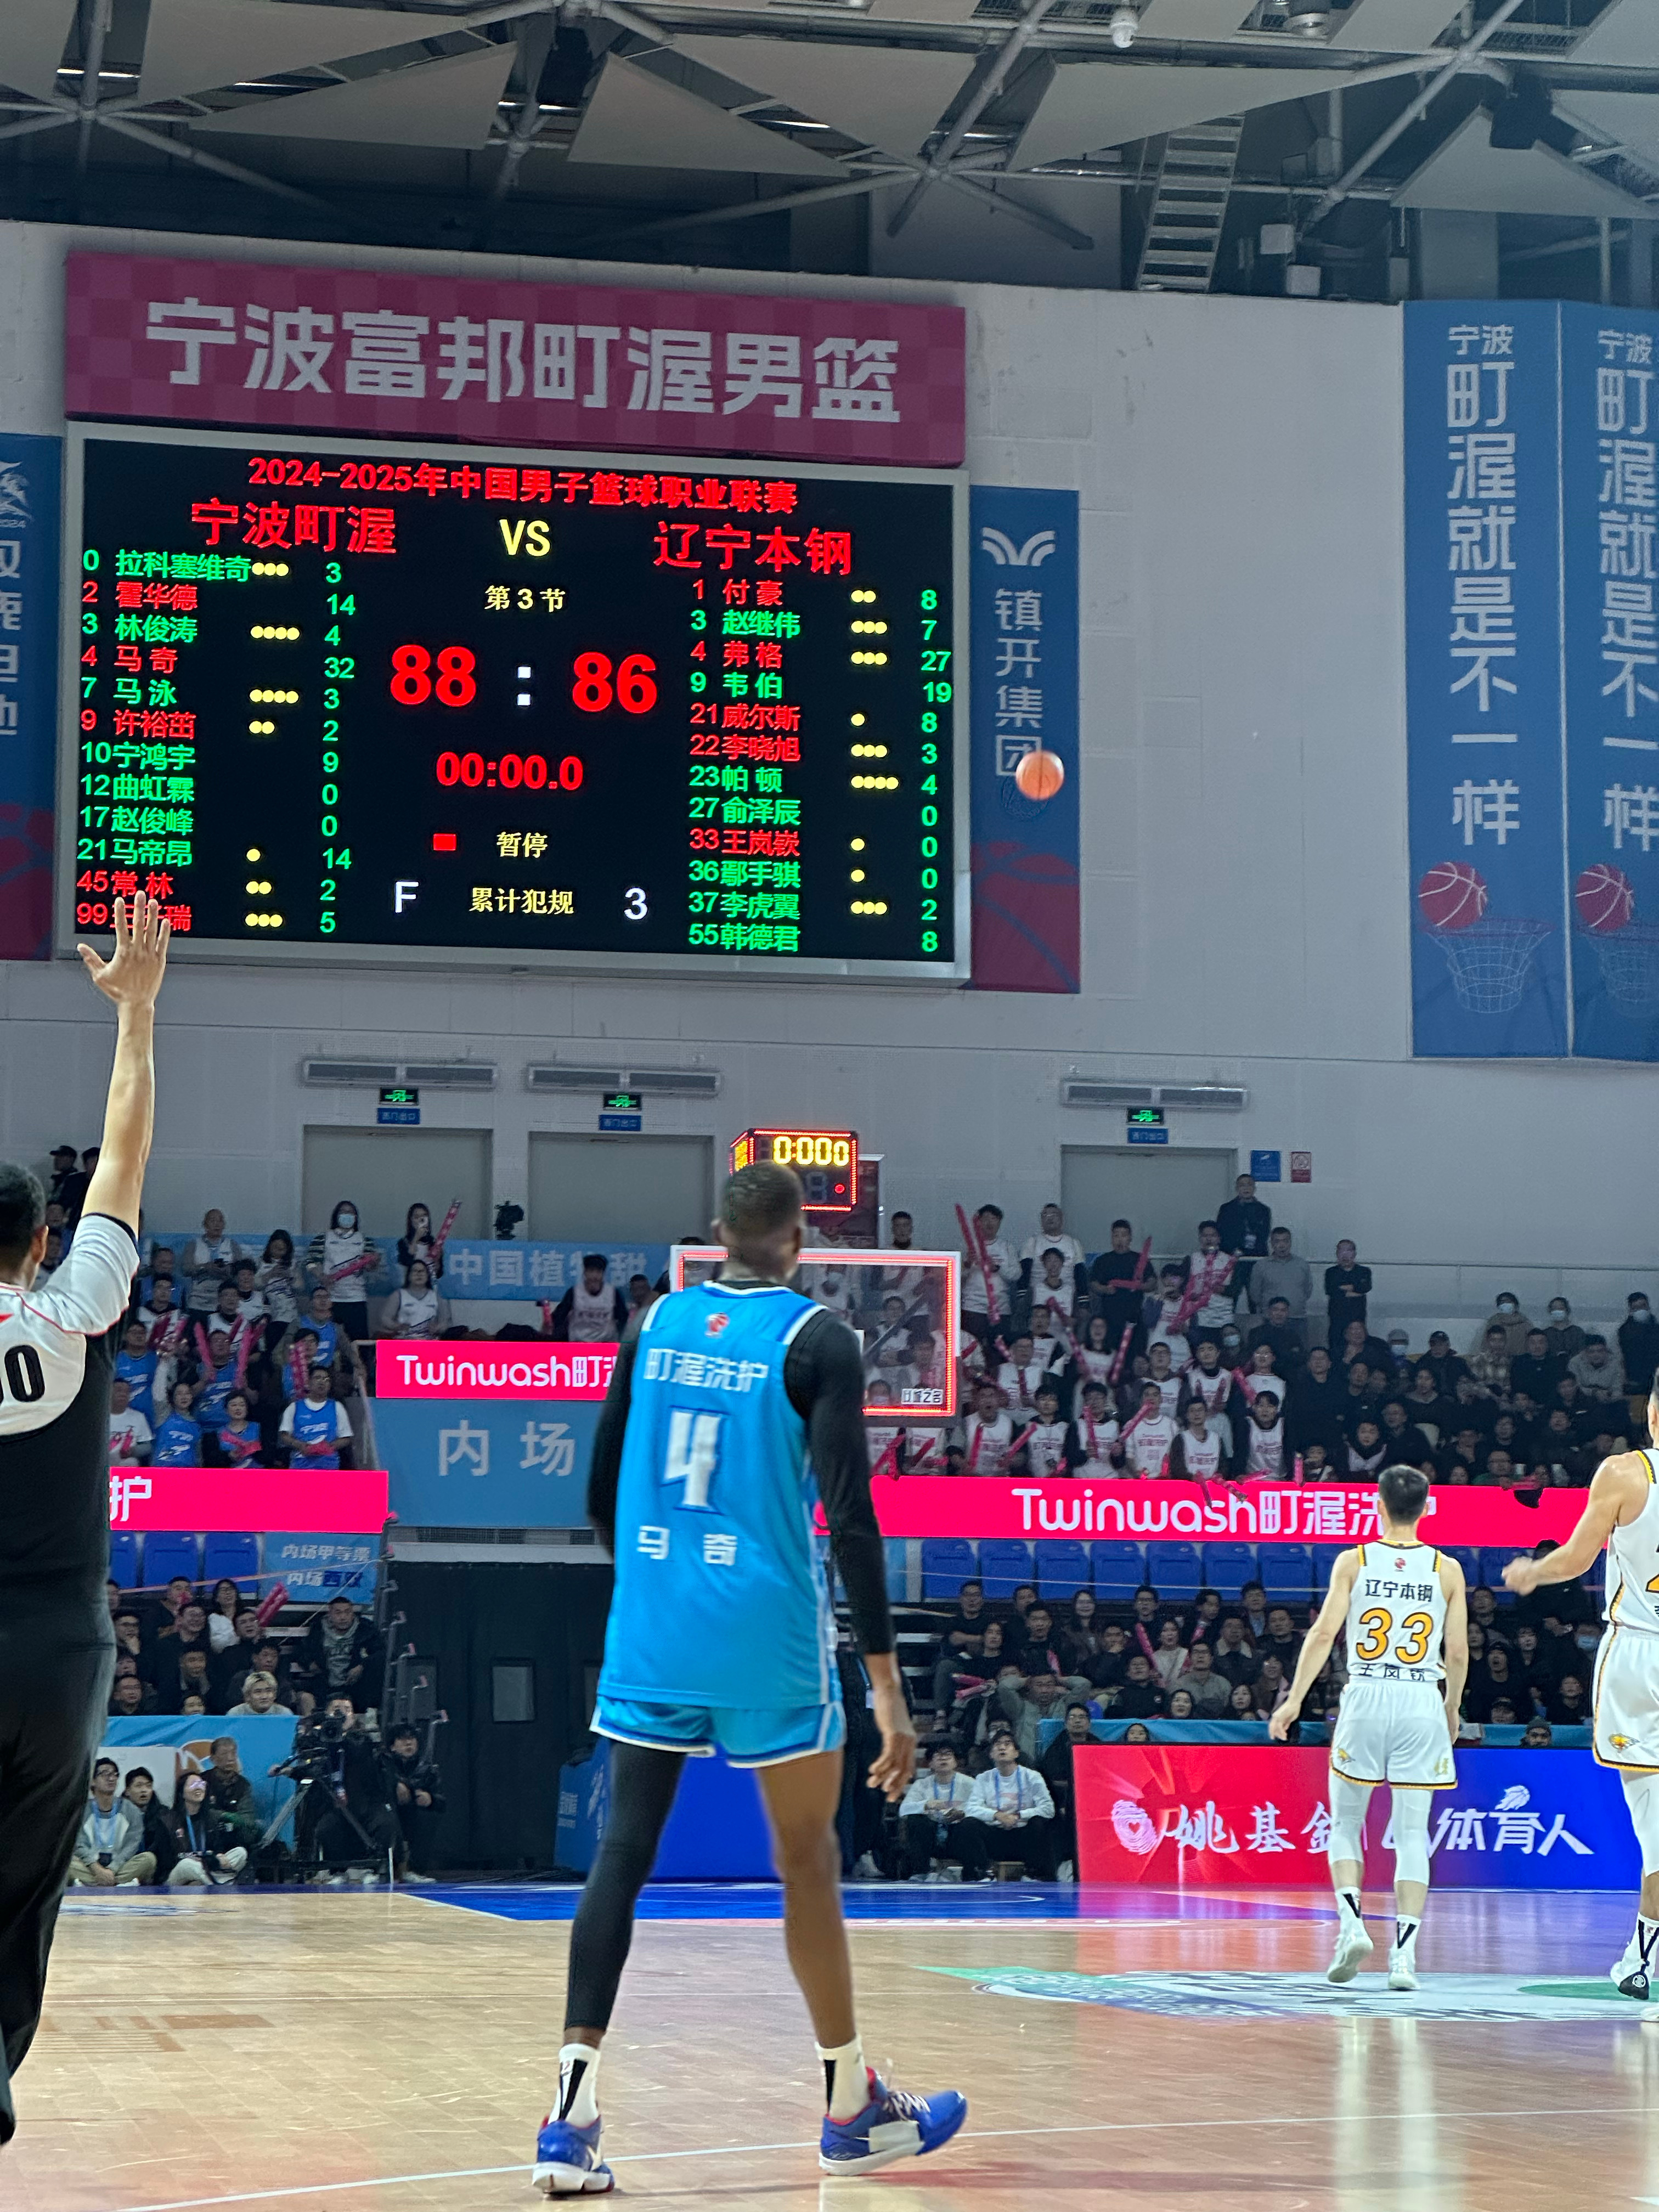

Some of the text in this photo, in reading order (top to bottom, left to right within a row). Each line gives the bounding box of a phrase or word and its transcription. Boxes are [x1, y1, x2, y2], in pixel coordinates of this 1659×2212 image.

[1447, 325, 1514, 356] 宁波
[1597, 329, 1654, 364] 宁波
[145, 296, 901, 423] 宁波富邦町渥男篮
[248, 456, 798, 513] 2024-2025年中国男子篮球职业联赛
[191, 497, 397, 555] 宁波町渥
[499, 519, 550, 557] VS
[653, 521, 851, 575] 辽宁本钢
[83, 549, 342, 584] 0 拉科塞维奇 3
[82, 580, 99, 603] 2
[326, 593, 356, 616] 14
[484, 585, 566, 613] 第3节
[693, 579, 703, 600] 1
[921, 589, 938, 610] 8
[1446, 361, 1521, 845] 町渥就是不一样
[1596, 366, 1659, 852] 町渥就是不一样
[82, 612, 341, 646] 3 林俊涛 4
[690, 609, 937, 641] 3 赵继伟 7
[81, 645, 98, 667] 4
[324, 657, 355, 679] 32
[690, 640, 707, 661] 4
[921, 650, 951, 672] 27
[81, 676, 97, 698] 7
[324, 688, 340, 709] 3
[390, 644, 476, 707] 88
[572, 652, 657, 714] 86
[690, 672, 707, 692] 9
[923, 681, 952, 703] 19
[995, 588, 1042, 776] 镇开集团
[81, 709, 97, 731] 9
[323, 720, 339, 742] 2
[690, 702, 938, 733] 21 威尔斯 8
[81, 741, 339, 773] 10 宁鸿宇 9
[690, 733, 938, 764] 22 李晓旭 3
[436, 752, 583, 791] 00:00.0
[689, 765, 720, 787] 23
[921, 774, 938, 795] 4
[81, 773, 338, 805] 12 曲虹霖 0
[80, 805, 337, 837] 17 赵俊峰 0
[689, 796, 938, 826] 27 俞泽辰 0
[77, 838, 352, 870] 21 马帝昂 14
[496, 831, 548, 859] 暂停
[689, 827, 938, 858] 33 王岚嵚 0
[76, 870, 109, 893] 45
[320, 879, 336, 901] 2
[689, 860, 720, 882] 36
[921, 868, 938, 889] 0
[395, 879, 648, 920] F 累计犯规 3
[689, 891, 938, 921] 37 李虎翼 2
[76, 902, 108, 925] 99
[320, 911, 336, 933] 5
[688, 922, 938, 952] 55 韩德君 8
[0, 1344, 45, 1402] 0
[644, 1348, 769, 1392] 町渥洗护
[661, 1405, 730, 1515] 4
[1012, 1488, 1437, 1536] Twinwash町渥洗
[1365, 1579, 1434, 1602] 辽宁本钢
[1356, 1607, 1434, 1665] 33
